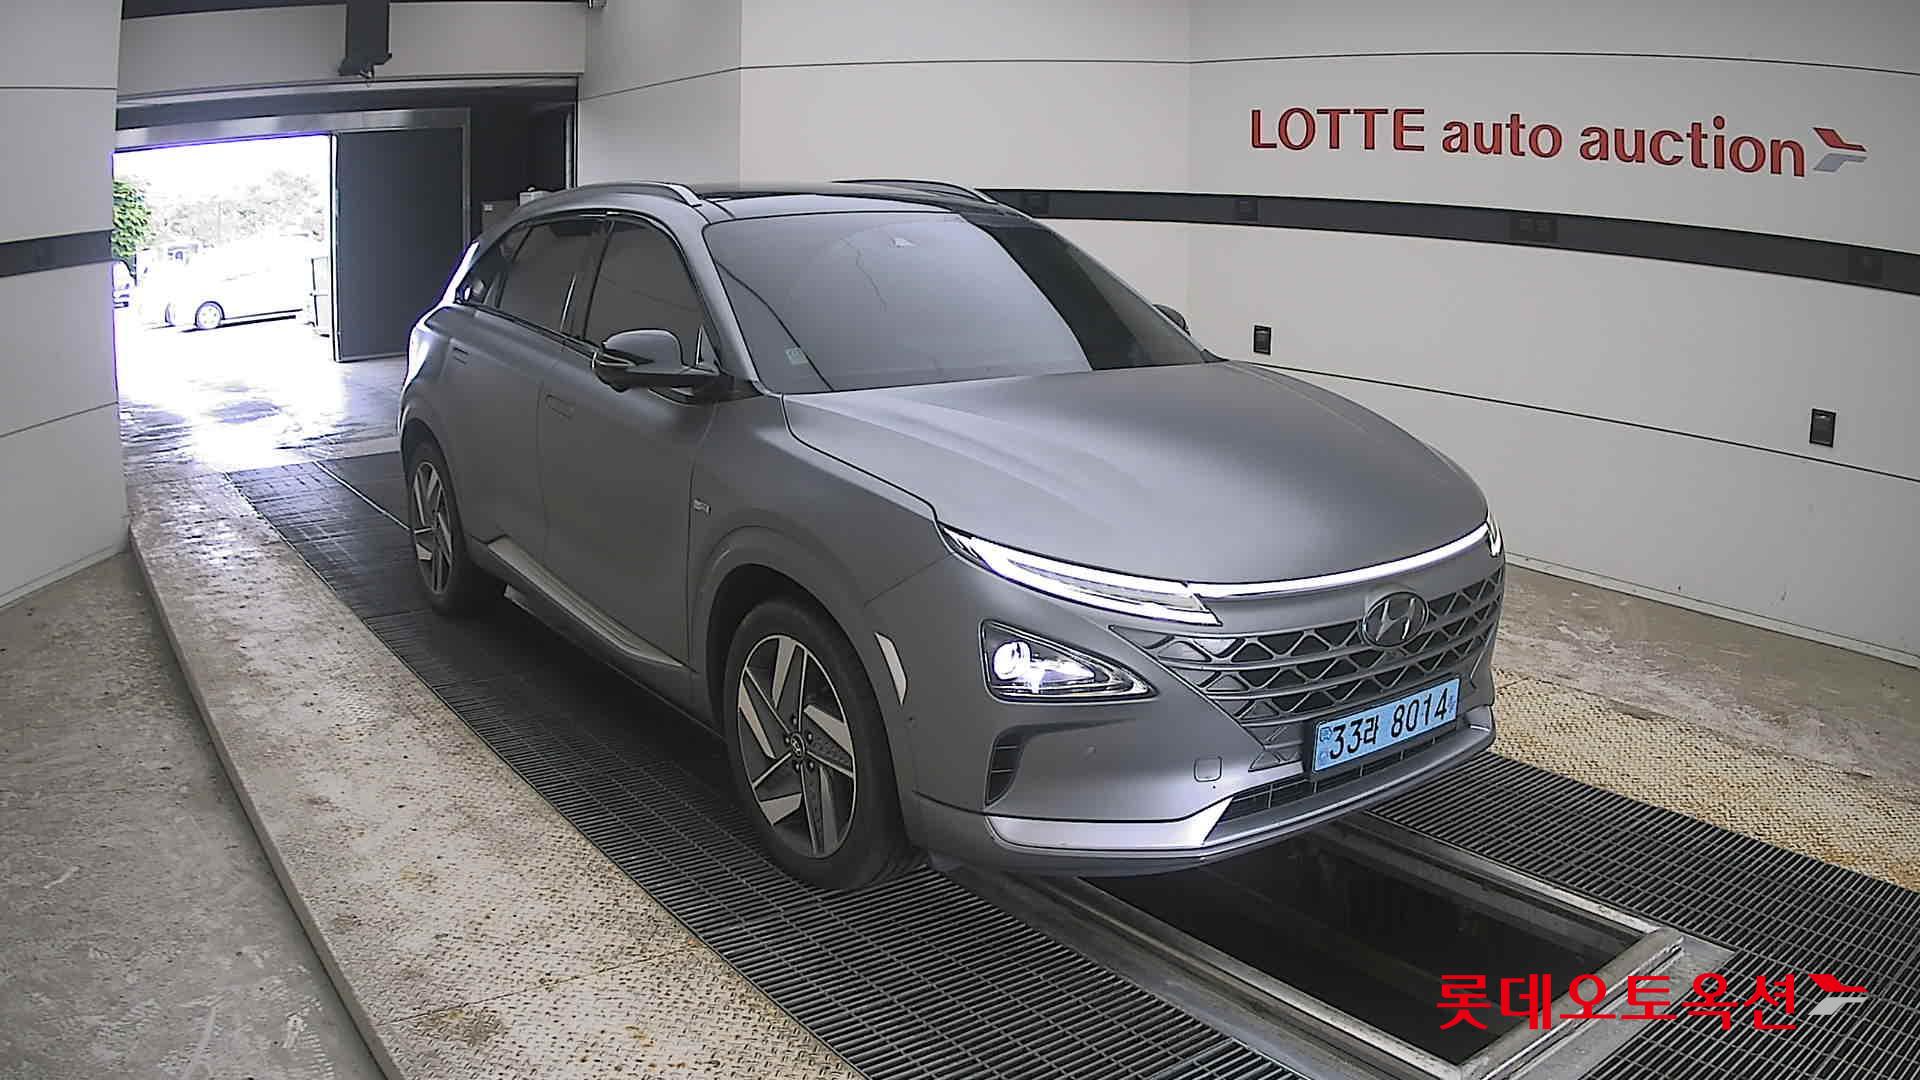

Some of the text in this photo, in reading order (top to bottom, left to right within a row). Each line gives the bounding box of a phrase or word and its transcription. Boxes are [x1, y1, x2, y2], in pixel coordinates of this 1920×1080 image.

[1250, 107, 1806, 177] LOTTE auto auction
[1329, 687, 1448, 759] 33라 8014
